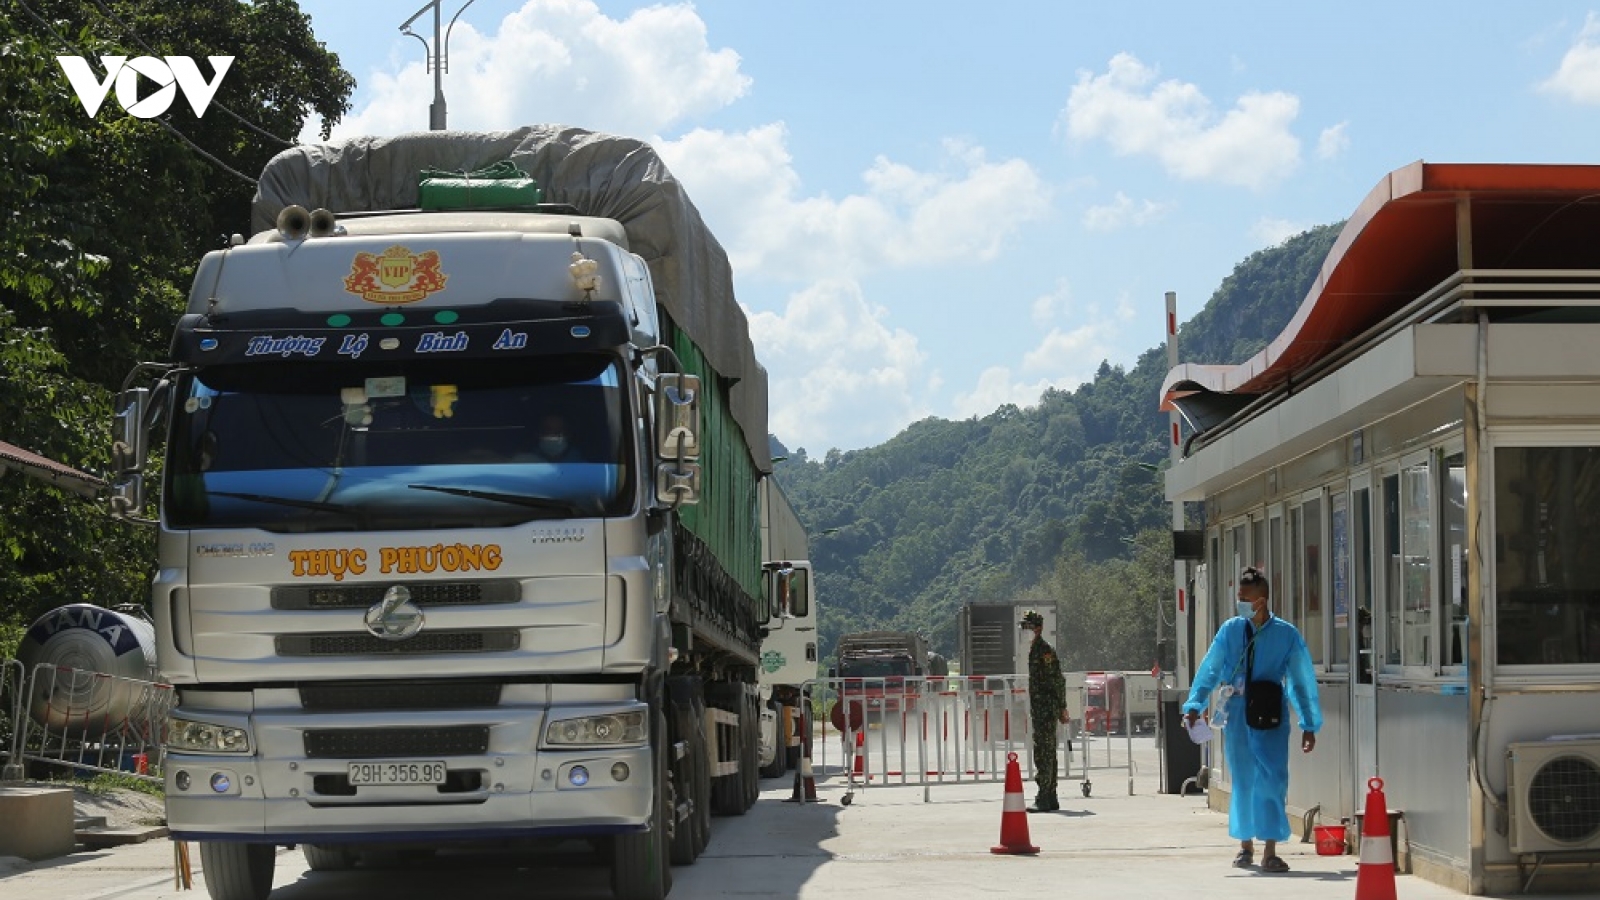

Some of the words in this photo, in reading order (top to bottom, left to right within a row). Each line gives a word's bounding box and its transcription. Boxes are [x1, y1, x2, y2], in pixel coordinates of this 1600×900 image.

[384, 266, 409, 278] VIP
[245, 335, 327, 357] Thượng
[337, 332, 370, 359] Lộ
[492, 328, 528, 350] An
[288, 548, 367, 581] THỤC
[379, 542, 503, 574] PHƯƠNG
